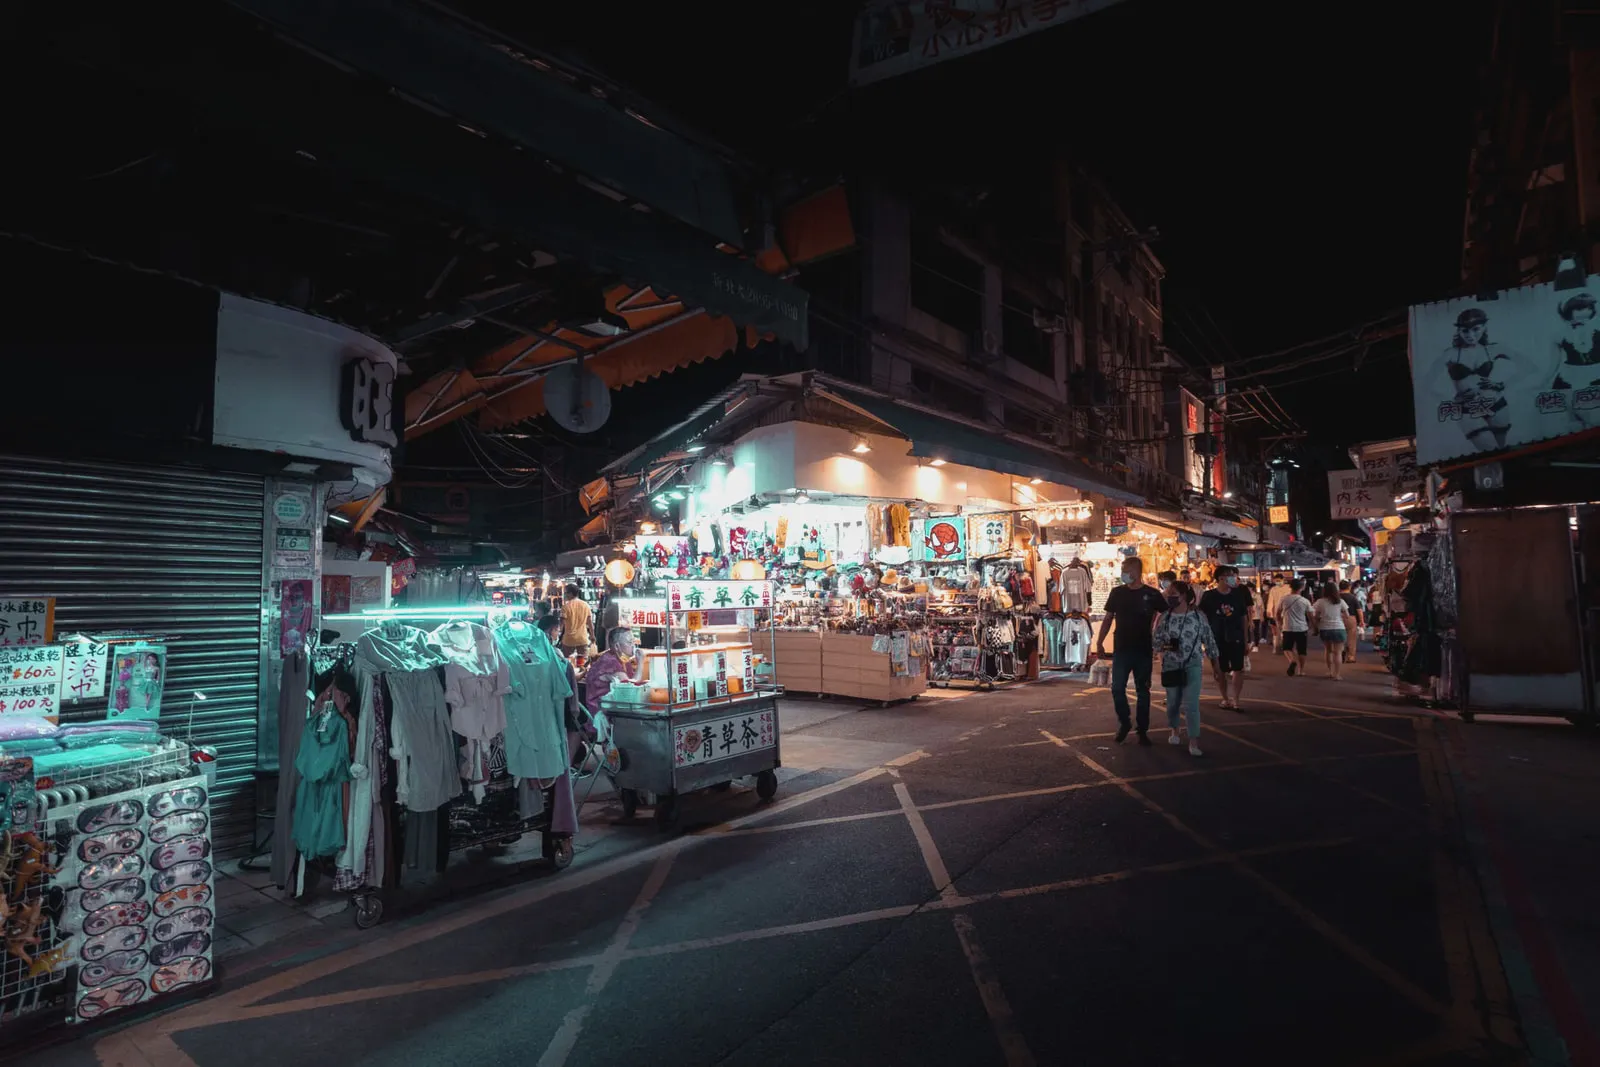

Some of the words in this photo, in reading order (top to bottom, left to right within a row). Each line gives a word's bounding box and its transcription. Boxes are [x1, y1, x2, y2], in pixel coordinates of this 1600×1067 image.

[342, 357, 398, 447] 旺
[684, 585, 760, 609] 青草茶
[677, 662, 689, 702] 酸梅湯
[700, 719, 759, 758] 青草茶
